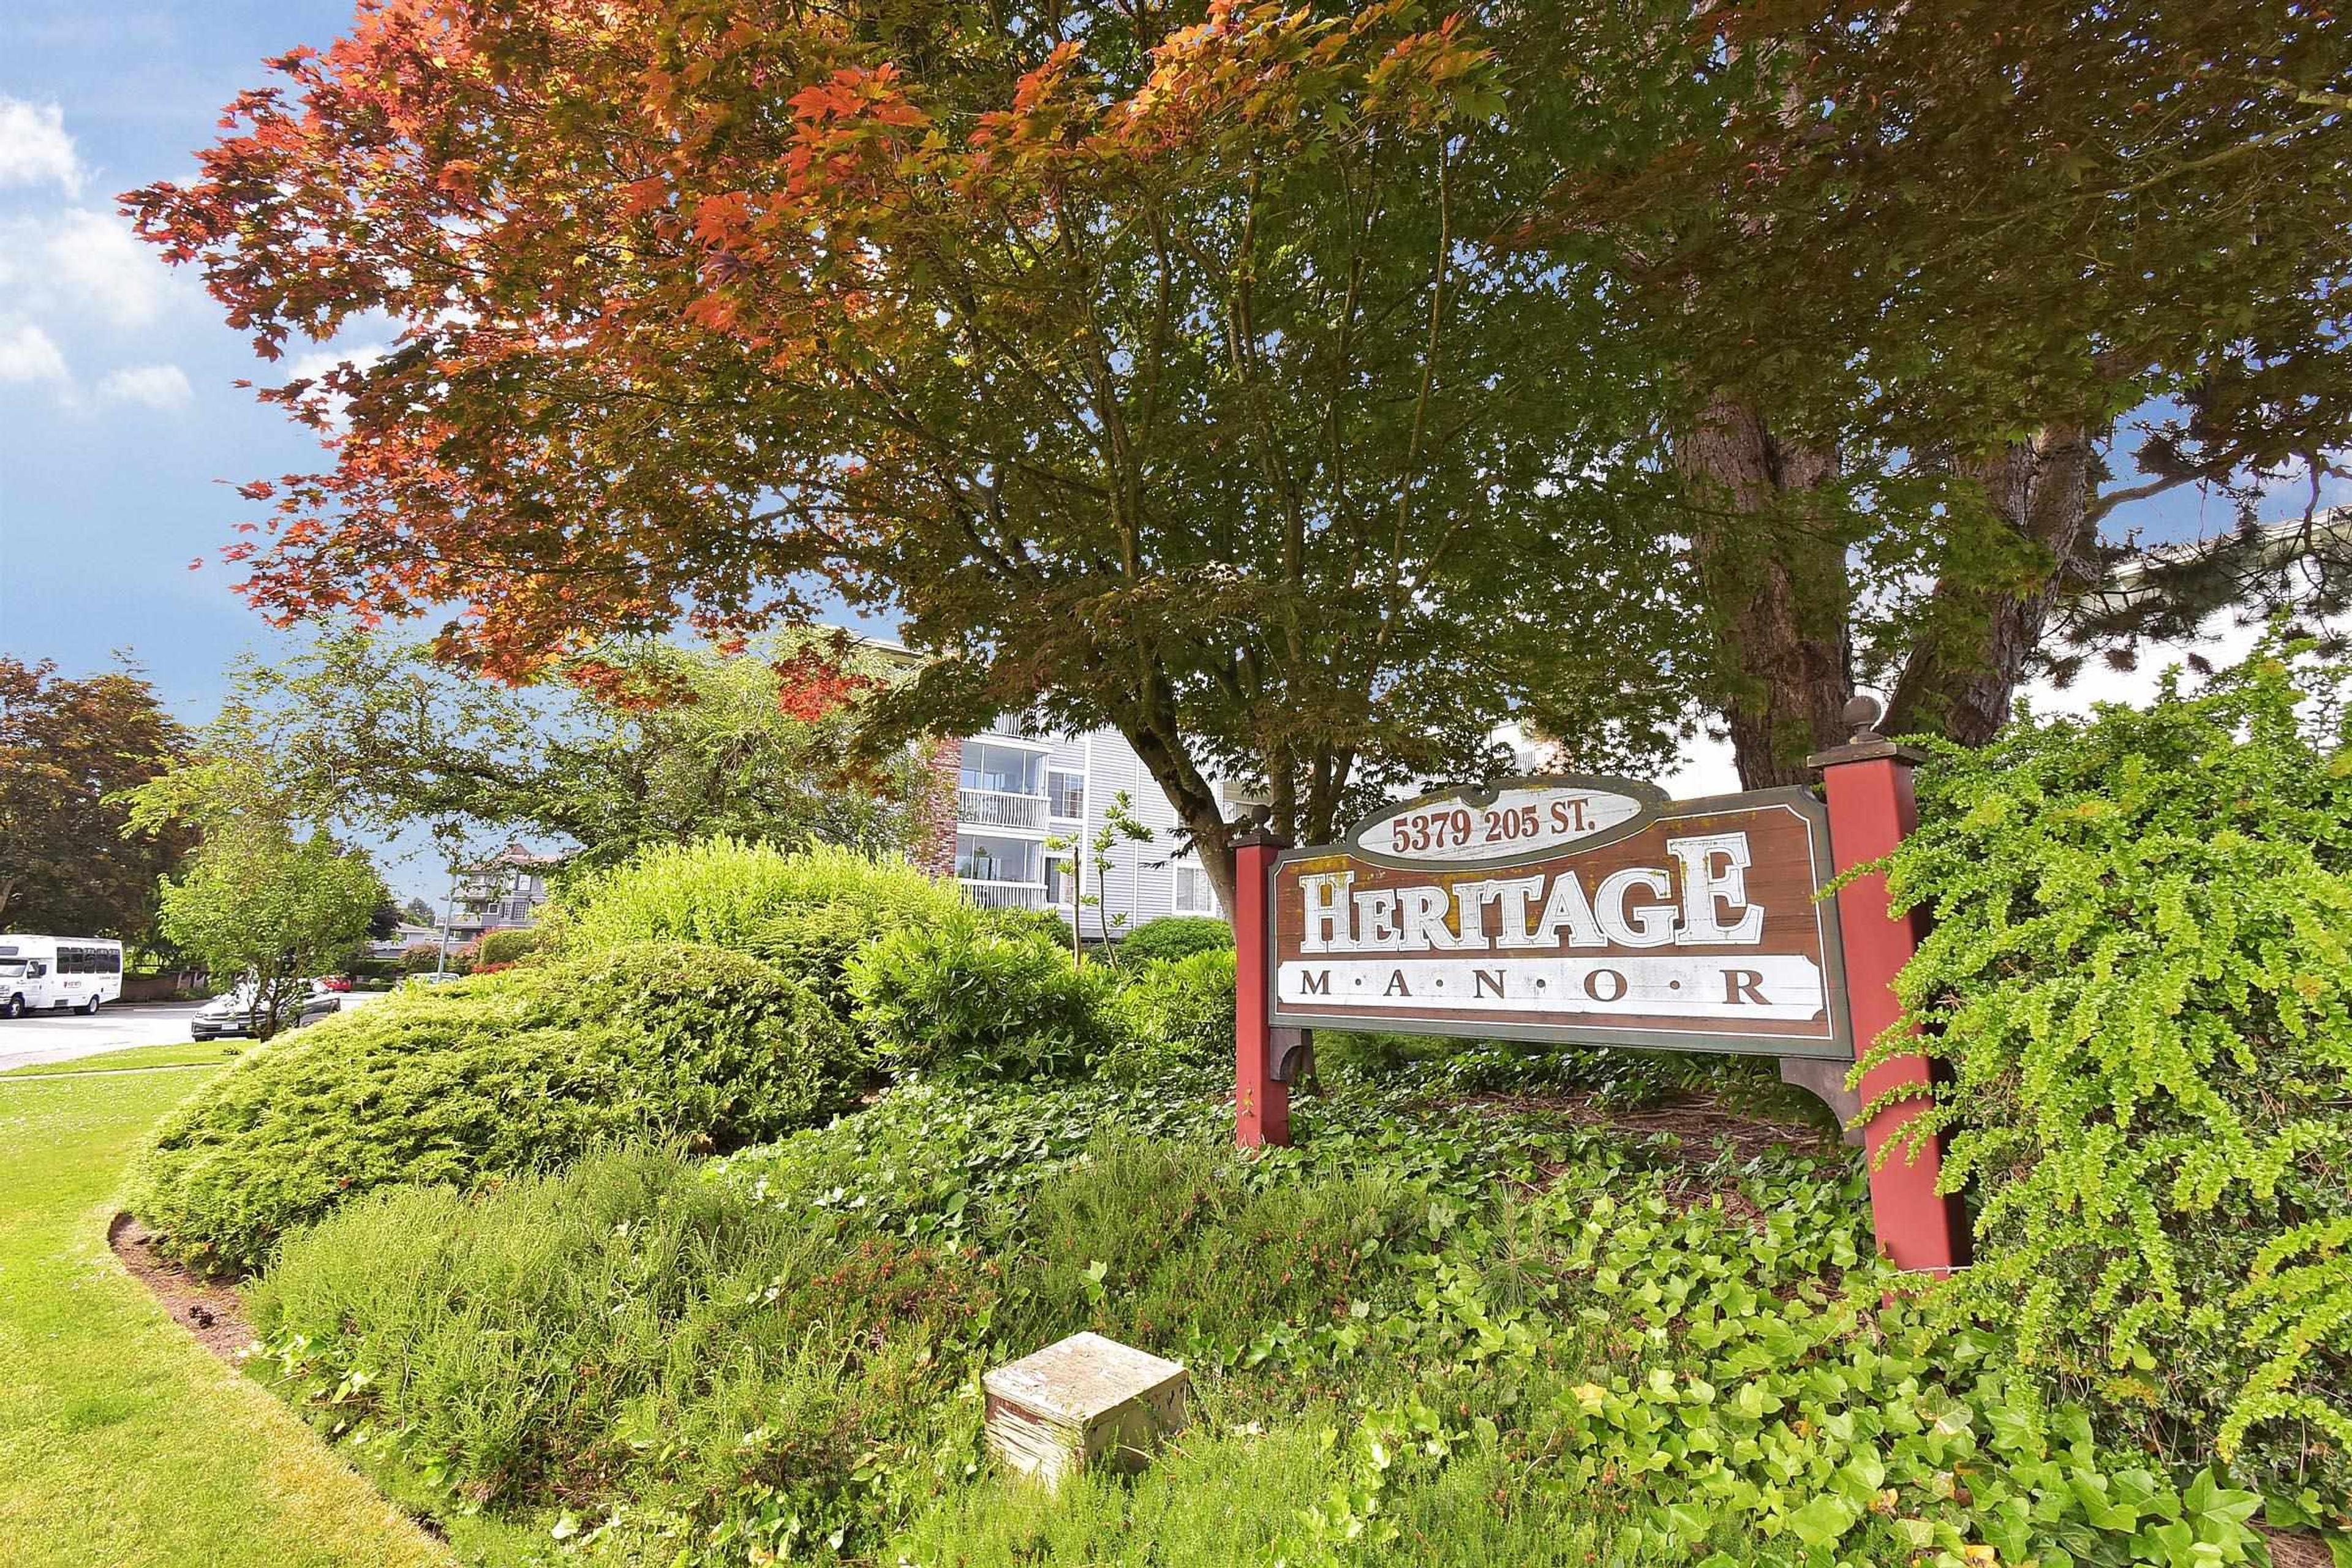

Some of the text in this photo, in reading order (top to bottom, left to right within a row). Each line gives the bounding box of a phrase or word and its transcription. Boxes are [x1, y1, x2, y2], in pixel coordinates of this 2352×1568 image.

[1392, 797, 1596, 853] 5379 205 ST.
[1298, 831, 1765, 954] HERITAGE
